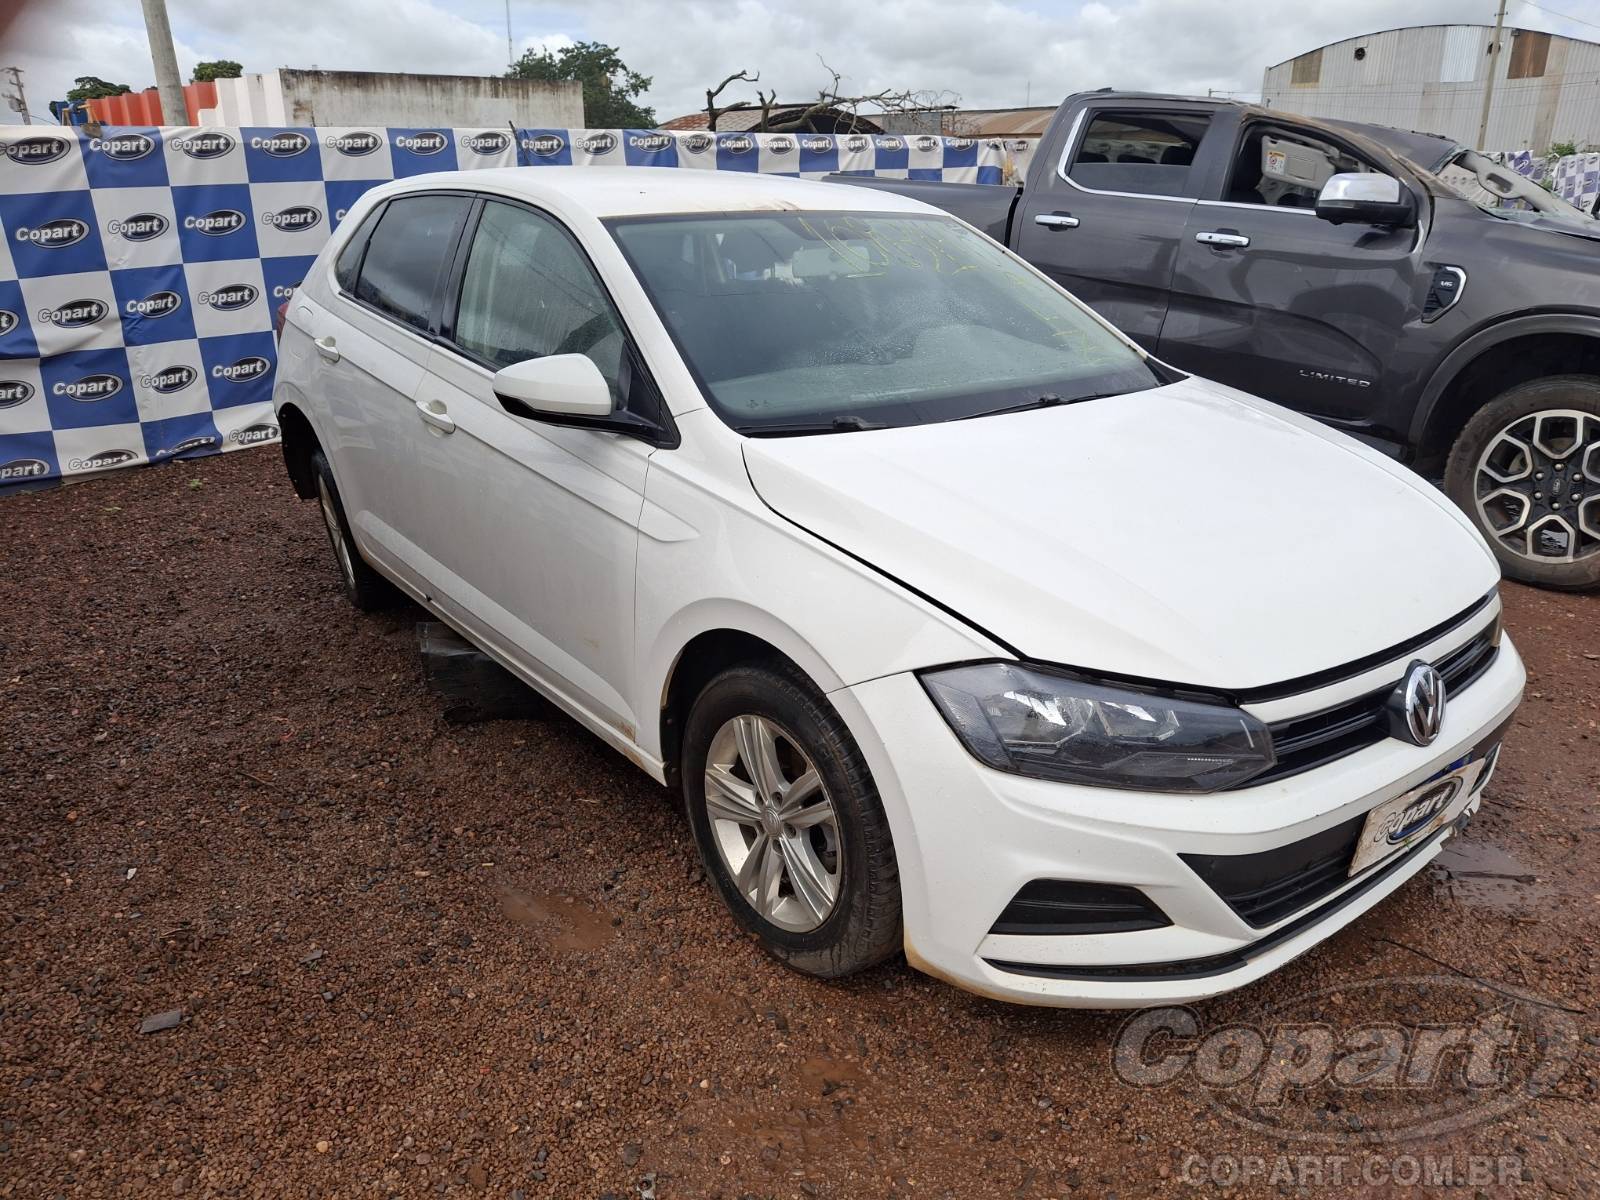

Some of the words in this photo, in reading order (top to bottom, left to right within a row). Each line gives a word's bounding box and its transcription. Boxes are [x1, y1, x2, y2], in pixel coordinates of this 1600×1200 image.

[89, 136, 146, 156] Copart
[171, 135, 228, 154] Copart
[251, 134, 303, 152] Copart
[326, 133, 374, 152] Copart
[396, 134, 441, 152] Copart
[461, 134, 503, 152] Copart
[521, 136, 559, 152] Copart
[576, 135, 612, 152] Copart
[629, 135, 669, 148] Copart
[680, 136, 708, 148] Copart
[720, 138, 750, 149] Copart
[802, 138, 831, 149] Copart
[108, 218, 160, 236] Copart
[184, 214, 238, 232] Copart
[262, 211, 313, 227] Copart
[16, 223, 80, 242] Copart
[126, 296, 174, 314] Copart
[198, 287, 251, 306] Copart
[38, 304, 100, 324] Copart
[212, 360, 263, 379] Copart
[1299, 369, 1371, 388] LIMITED
[53, 378, 114, 398] Copart
[140, 370, 188, 390] Copart
[229, 426, 275, 445] Copart
[68, 453, 129, 473] Copart
[1374, 786, 1453, 842] Copart
